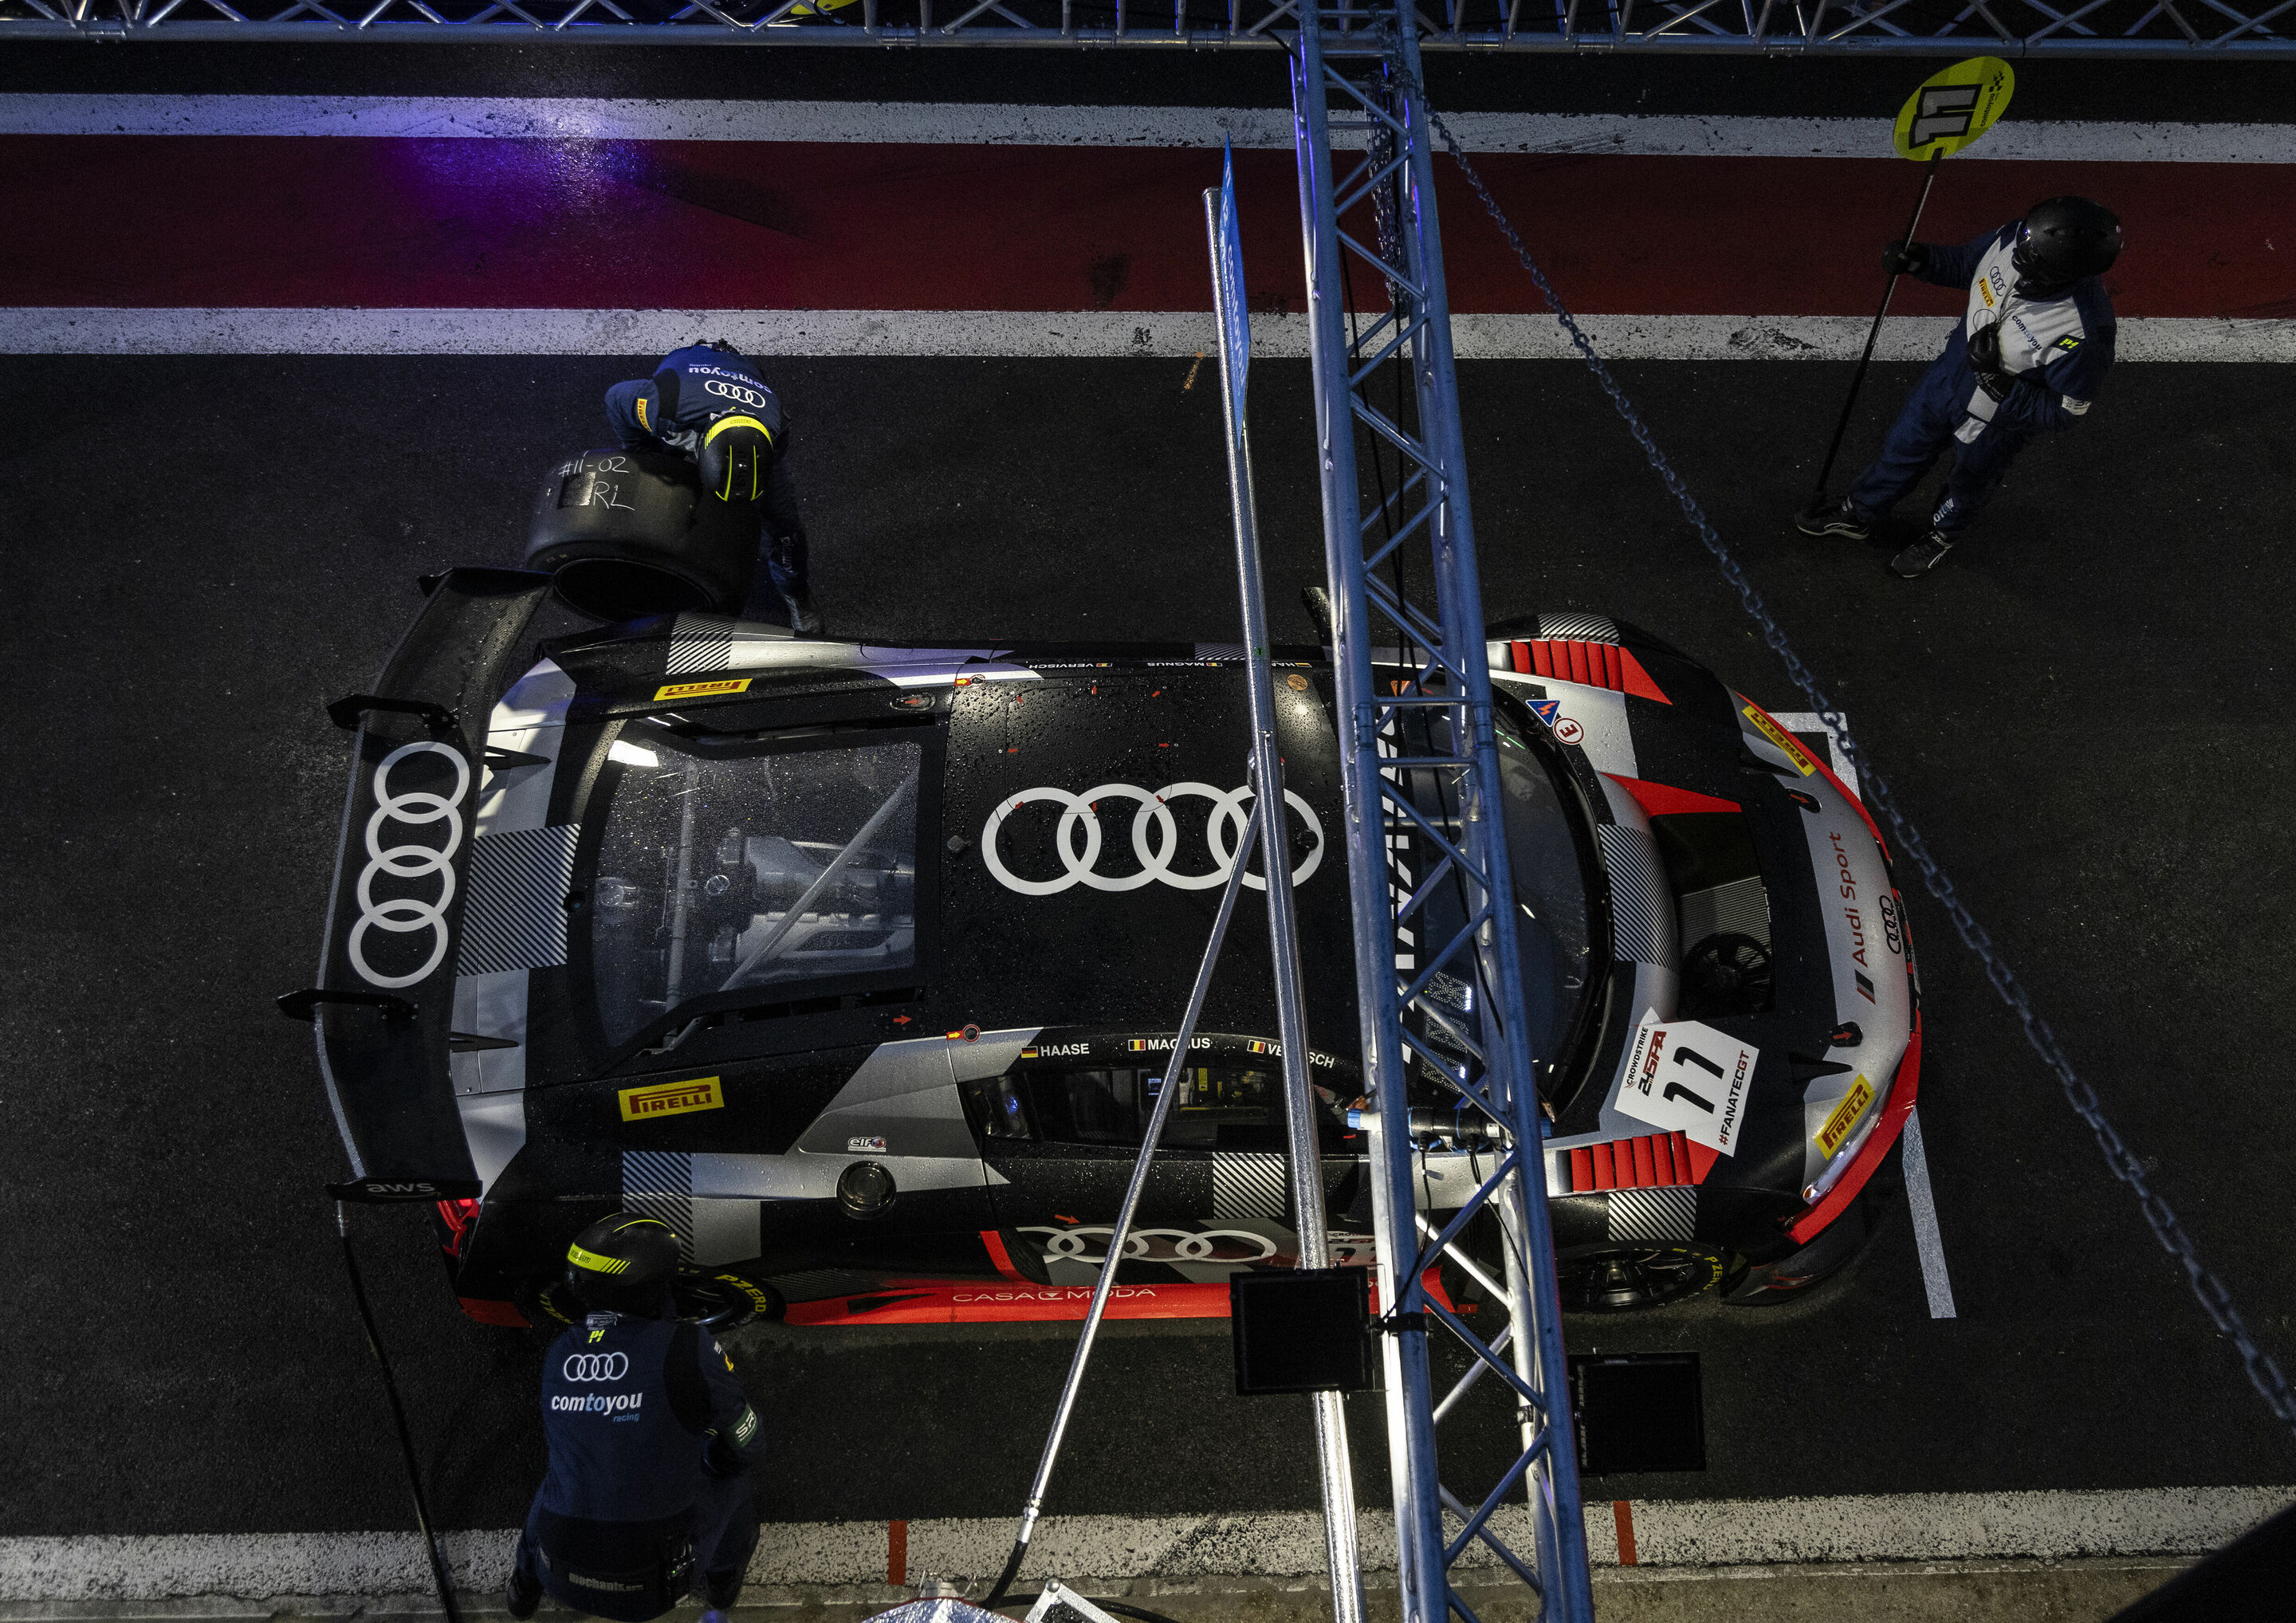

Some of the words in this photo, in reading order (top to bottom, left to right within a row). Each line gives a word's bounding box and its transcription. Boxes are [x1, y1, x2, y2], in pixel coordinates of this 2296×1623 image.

[1909, 84, 1983, 150] 11
[2011, 315, 2042, 351] comtoyou
[593, 481, 635, 511] RL
[664, 681, 742, 697] PIRELLI
[1559, 724, 1579, 738] E
[1751, 713, 1809, 768] PIRELLI
[1829, 831, 1856, 900] Sport
[1844, 907, 1868, 968] Audi
[1040, 1043, 1090, 1057] HAASE
[1268, 1043, 1335, 1069] VESCH
[1626, 1027, 1649, 1086] CROWDSTRIKE
[1663, 1046, 1725, 1115] 11
[629, 1084, 712, 1114] PIRELLI
[1719, 1049, 1750, 1146] #FANATECGT
[1821, 1083, 1869, 1149] PIRELLI
[366, 1183, 435, 1193] aws
[1067, 1288, 1156, 1299] MDA
[551, 1392, 643, 1416] comtoyou
[612, 1413, 640, 1423] racing
